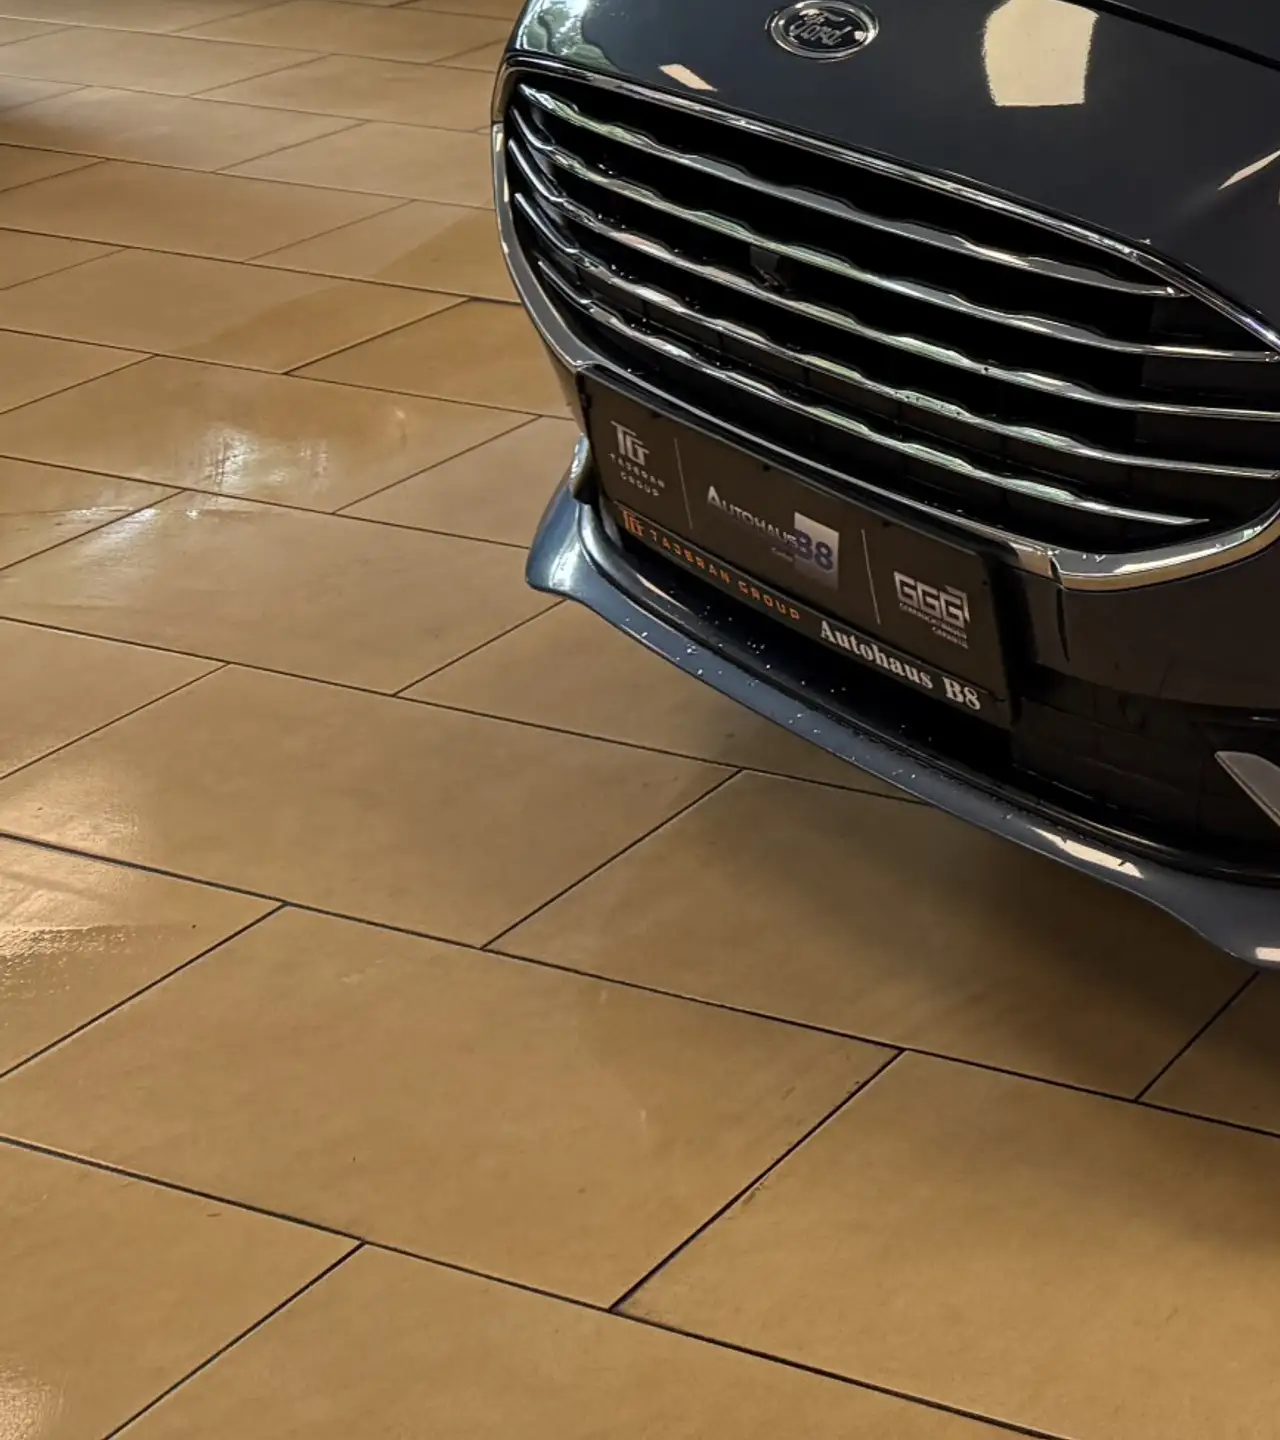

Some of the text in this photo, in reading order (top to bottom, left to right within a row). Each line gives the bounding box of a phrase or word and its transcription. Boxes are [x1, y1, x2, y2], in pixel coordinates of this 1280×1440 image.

[788, 19, 854, 46] Ford
[819, 620, 934, 690] Autohaus
[941, 676, 982, 711] B8
